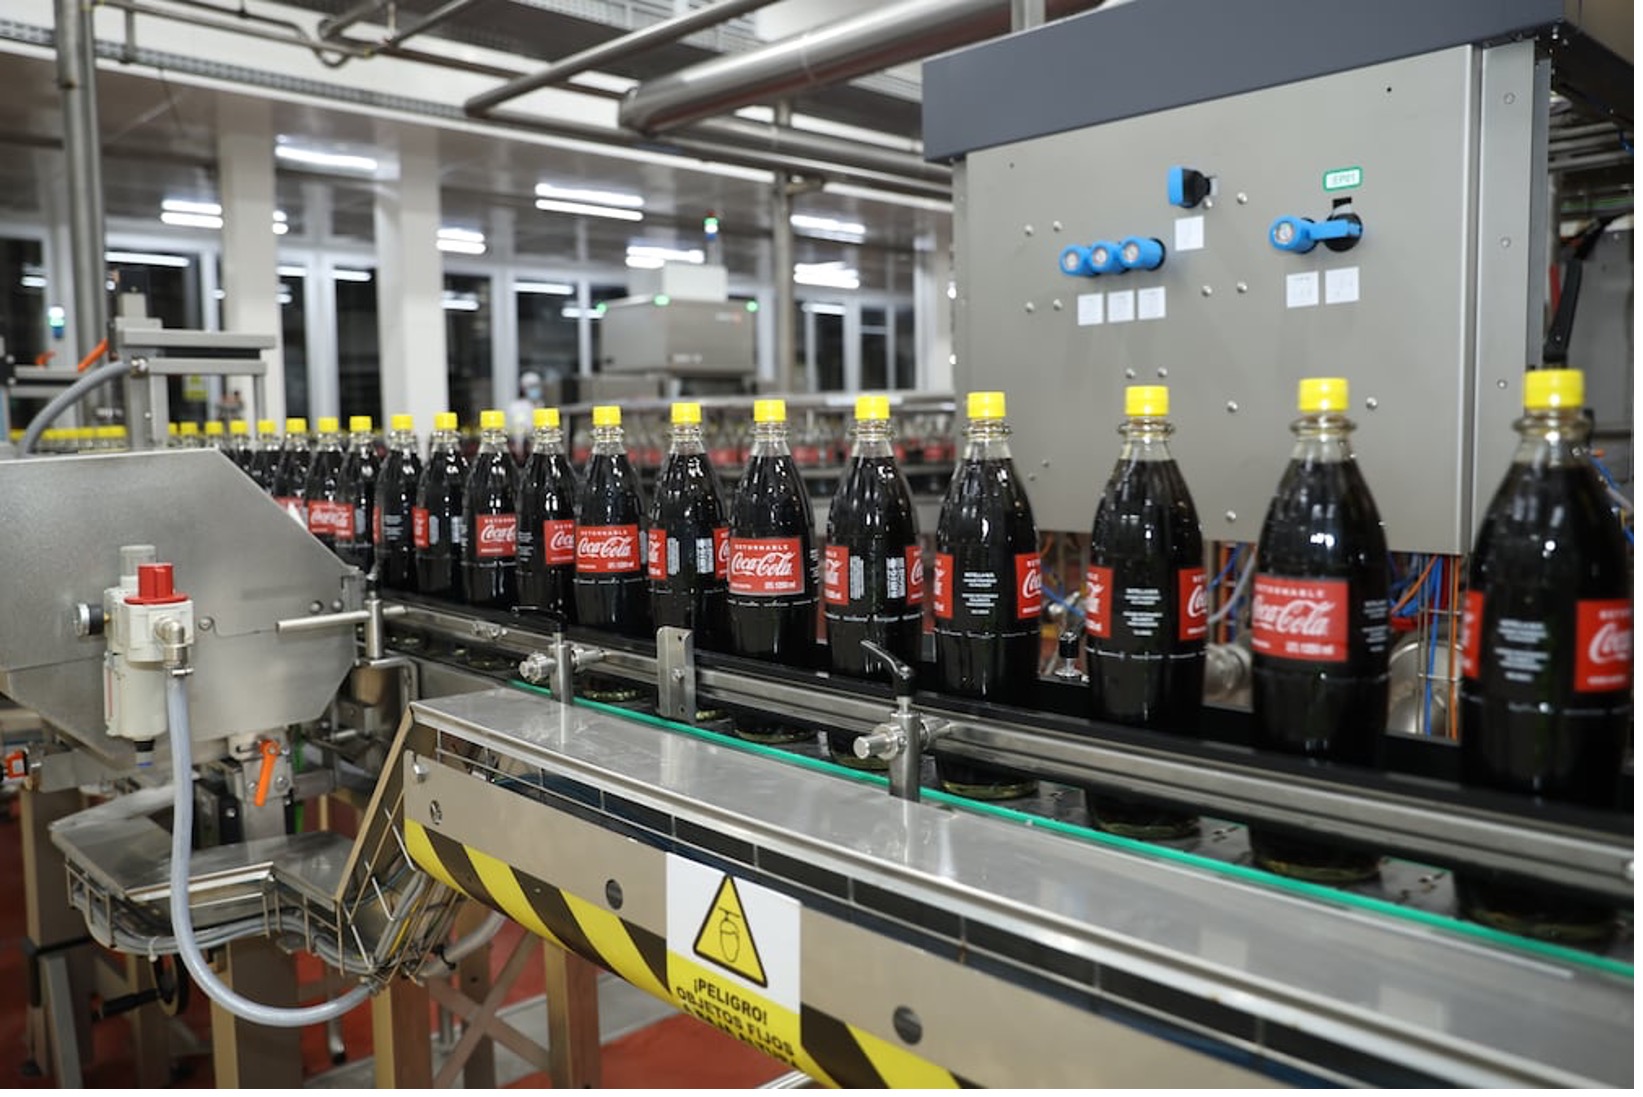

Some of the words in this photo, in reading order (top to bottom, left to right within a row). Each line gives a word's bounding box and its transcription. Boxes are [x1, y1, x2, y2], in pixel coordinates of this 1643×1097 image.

[577, 536, 634, 559] Coca-Cola
[731, 552, 796, 577] Coca-Cola
[693, 977, 768, 1026] ¡PELIGRO!
[676, 986, 742, 1029] OBJETOS
[747, 1022, 794, 1056] FIJOS
